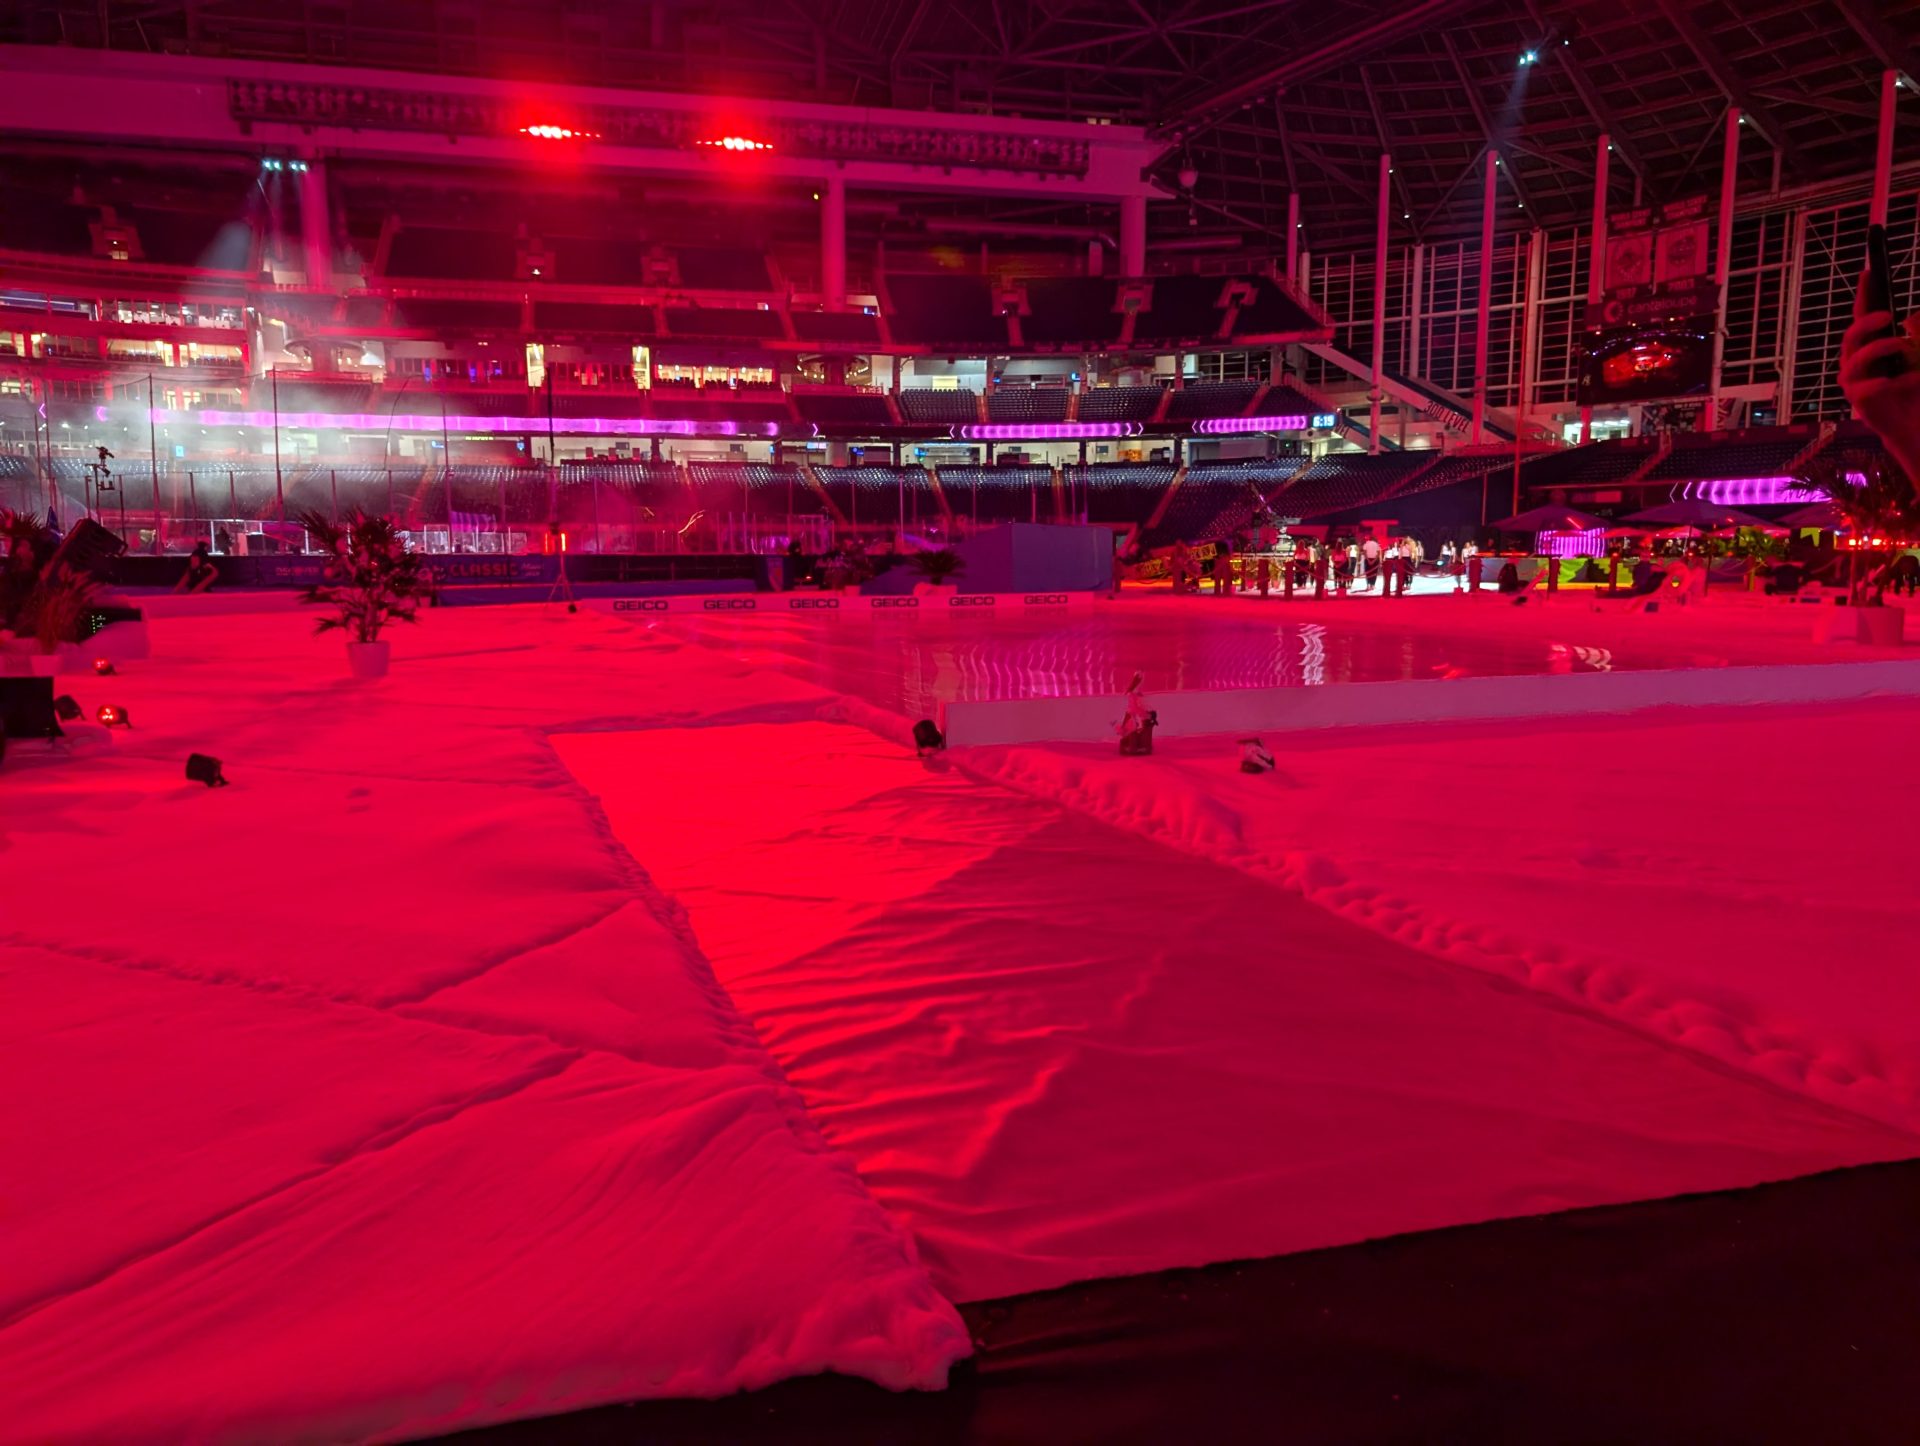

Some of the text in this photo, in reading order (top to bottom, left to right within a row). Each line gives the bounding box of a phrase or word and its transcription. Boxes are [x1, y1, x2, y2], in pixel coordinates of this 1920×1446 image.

[1627, 295, 1698, 314] cantaloupe
[1425, 401, 1470, 433] 300 LEVEL
[450, 562, 519, 577] CLASSIC
[613, 599, 669, 611] GEICO
[703, 598, 756, 610] GEICO
[790, 598, 840, 609] GEICO
[871, 597, 919, 608] GEICO
[949, 596, 995, 607] GEICO
[1024, 595, 1068, 605] GEICO
